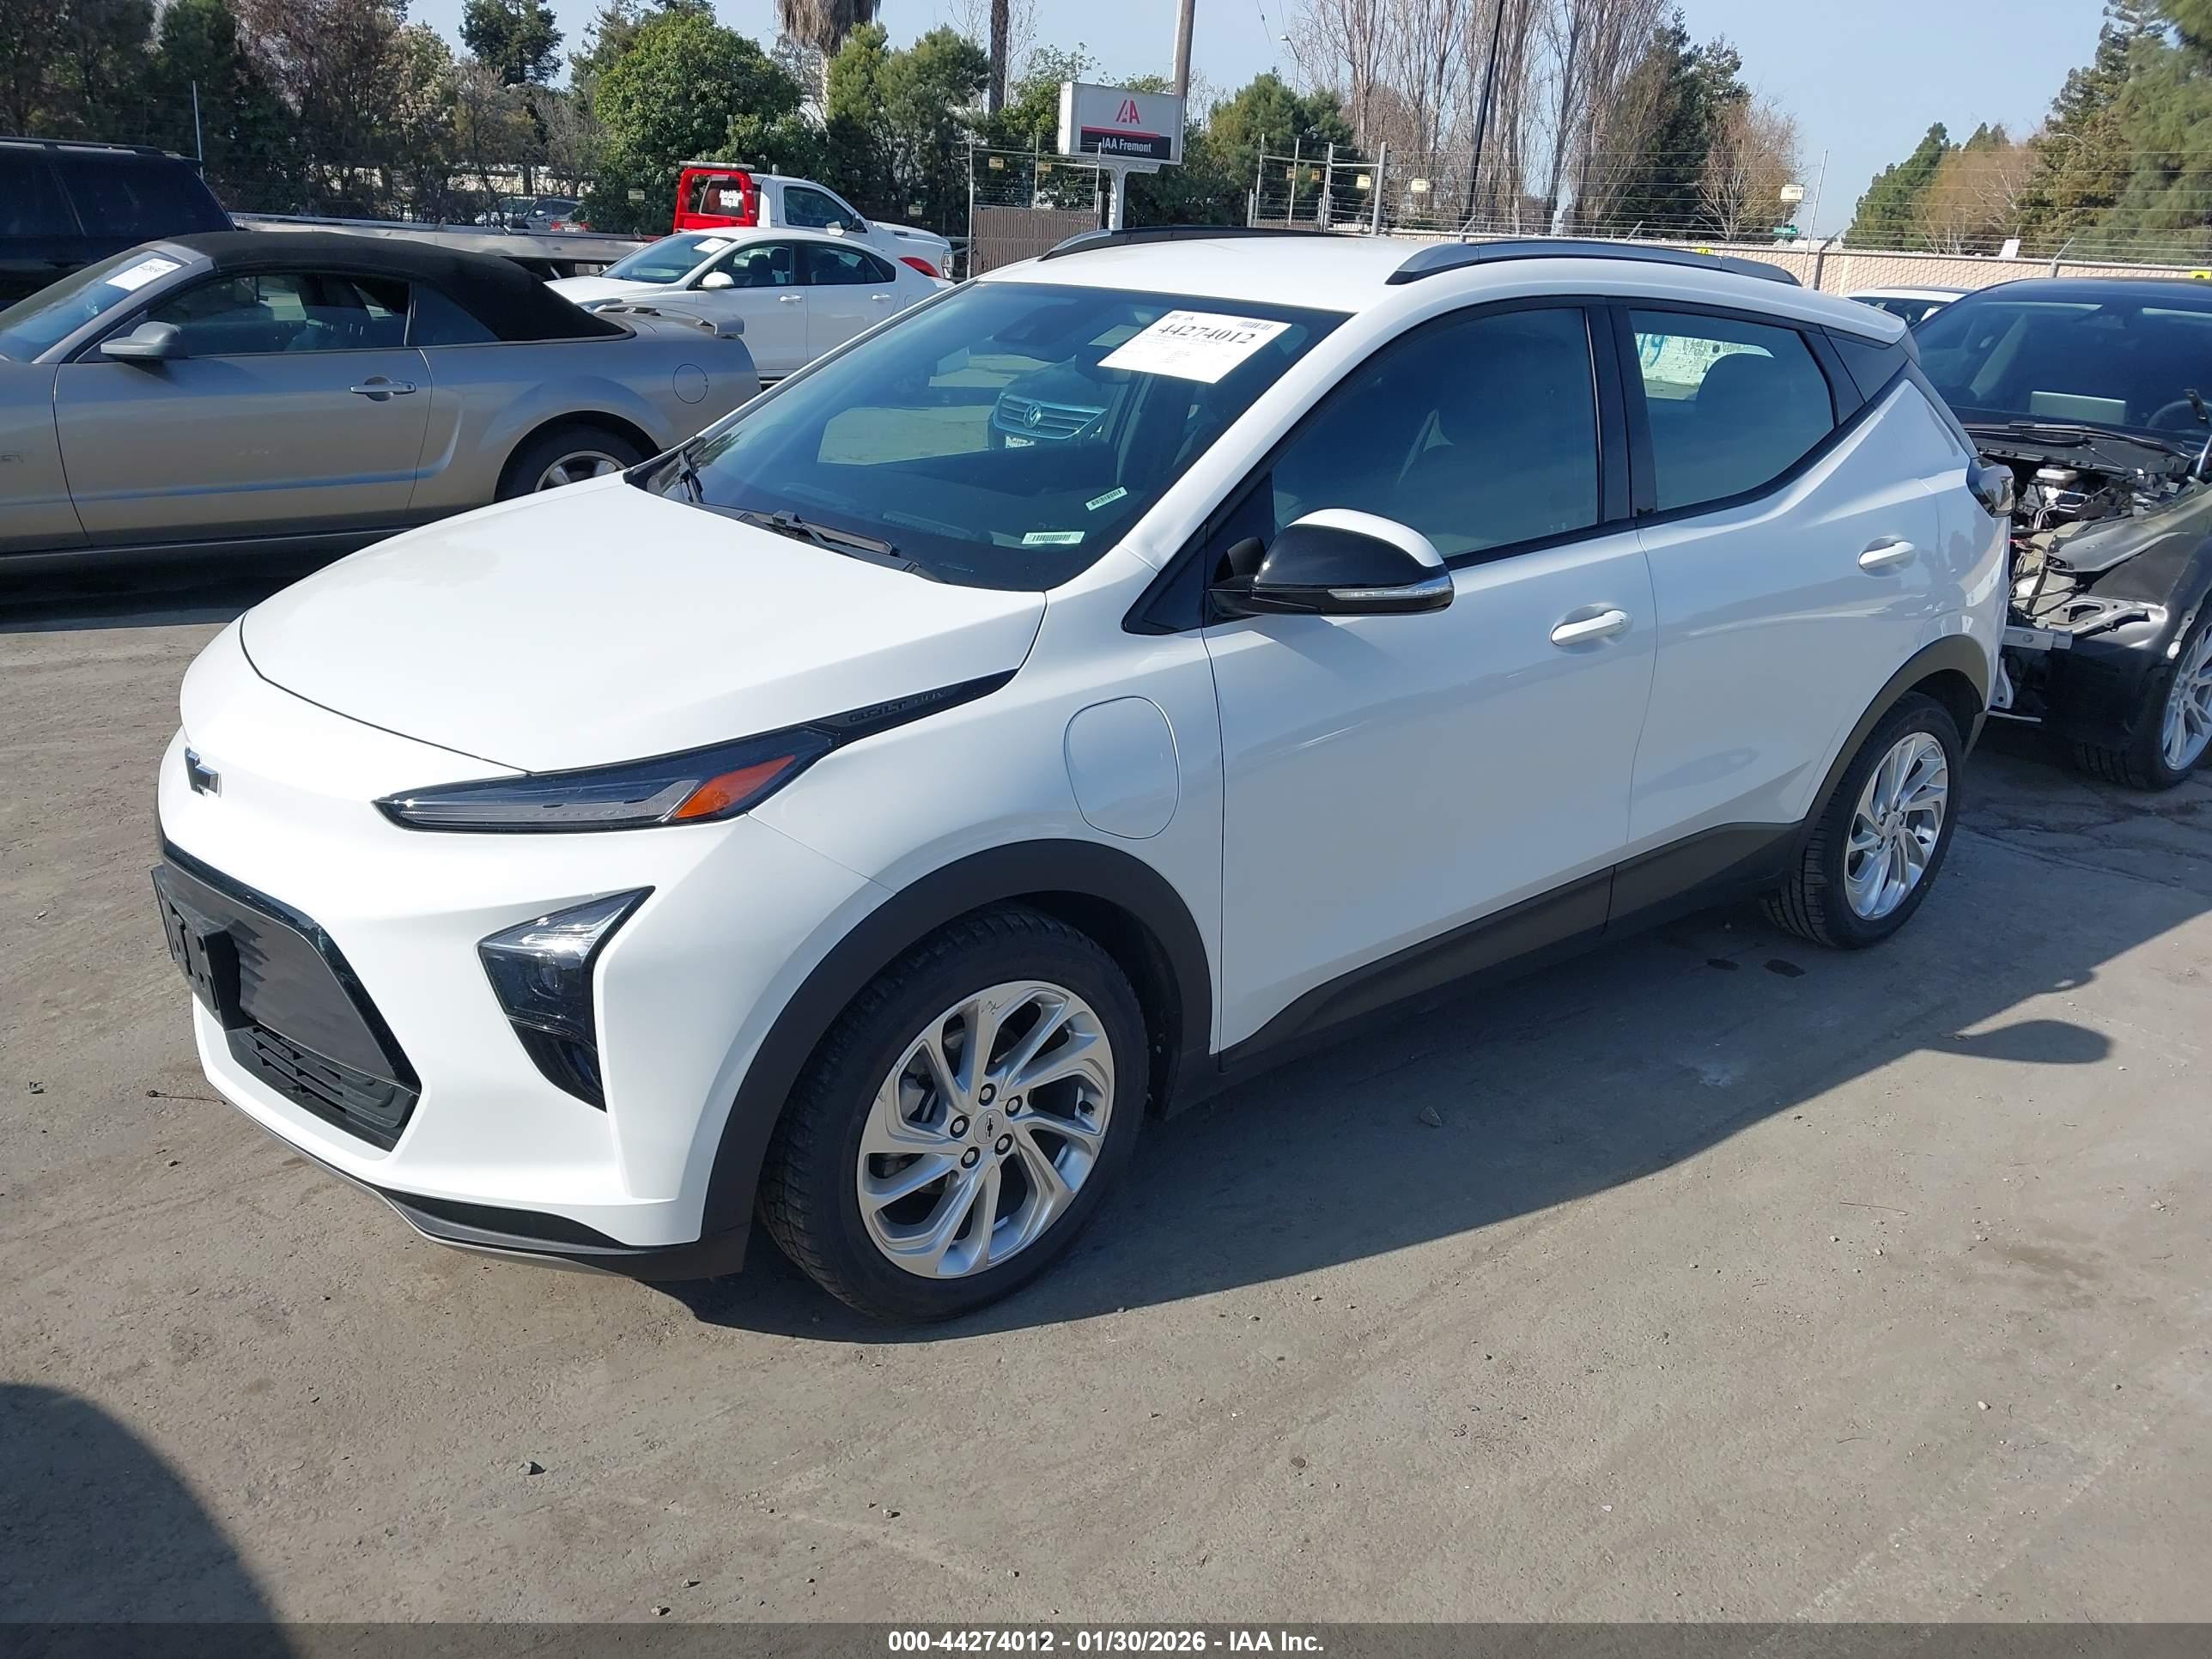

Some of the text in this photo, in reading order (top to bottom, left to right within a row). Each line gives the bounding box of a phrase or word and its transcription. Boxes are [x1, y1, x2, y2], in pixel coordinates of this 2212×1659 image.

[1102, 137, 1152, 153] IAA Fremont
[1158, 323, 1256, 344] 44274012
